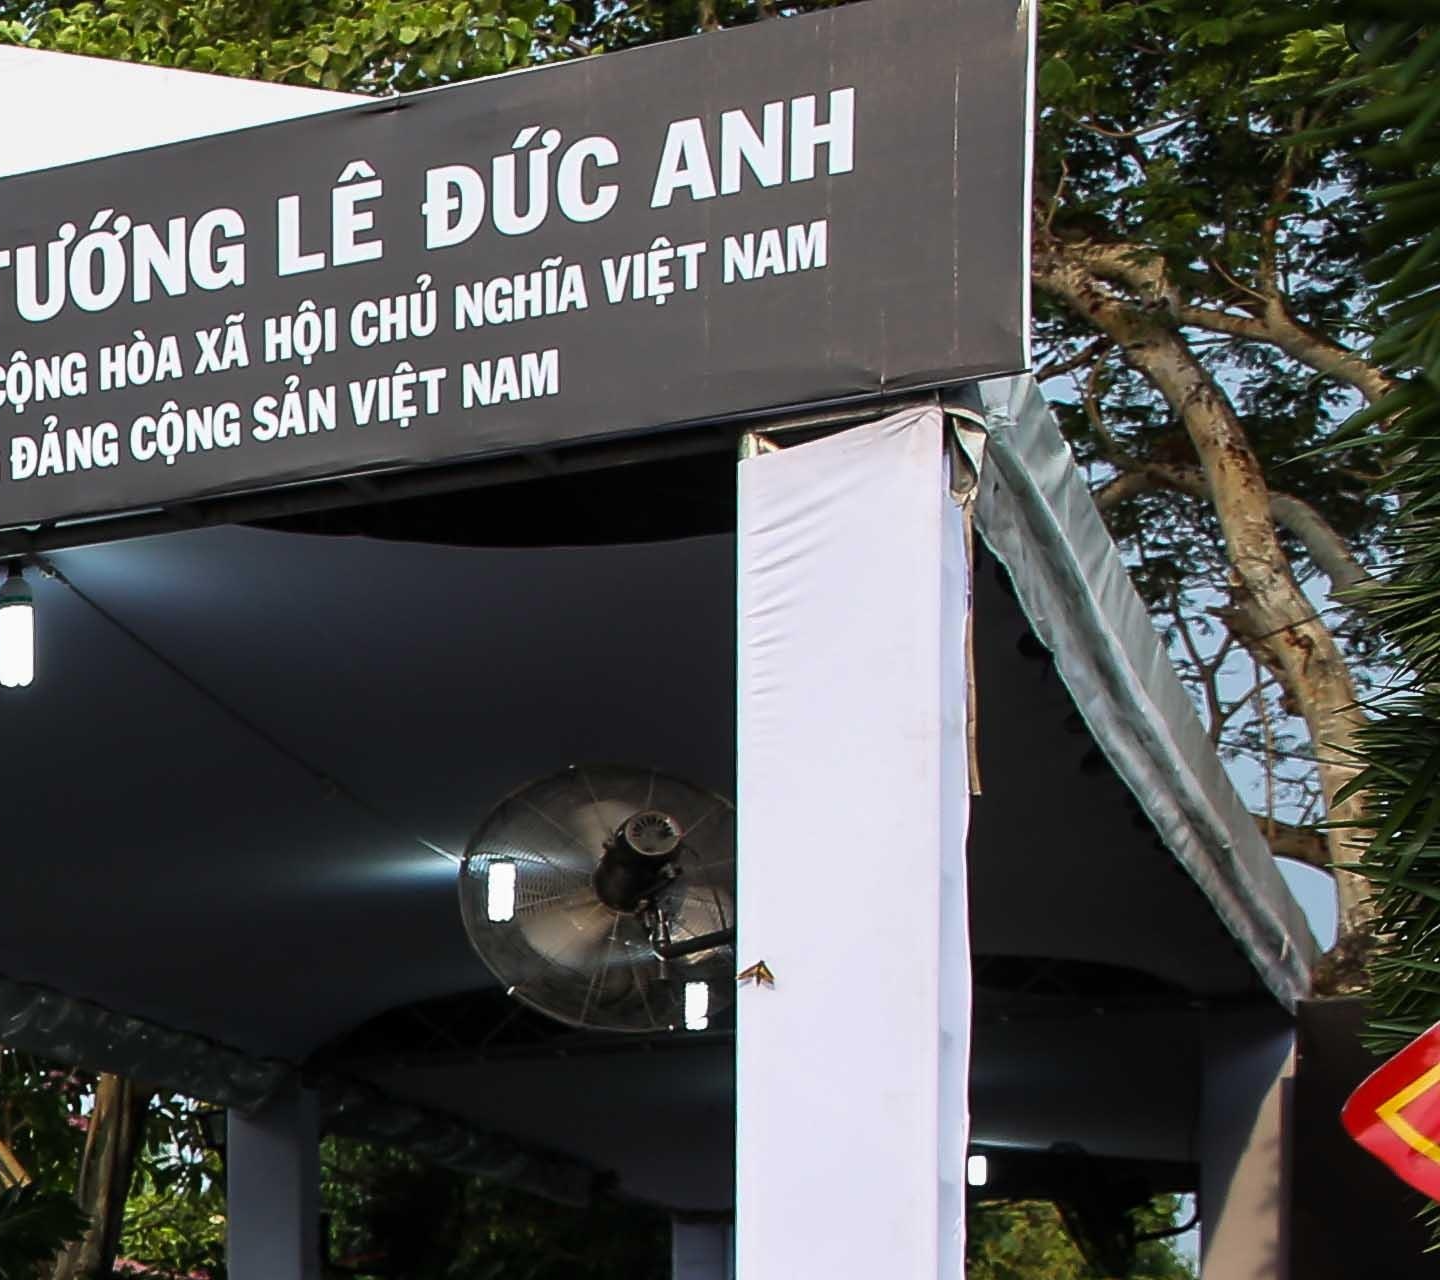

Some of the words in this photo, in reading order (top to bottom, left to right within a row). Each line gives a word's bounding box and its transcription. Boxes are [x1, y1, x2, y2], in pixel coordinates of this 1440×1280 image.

[278, 160, 383, 276] LÊ
[421, 125, 619, 249] ĐỨC
[650, 87, 855, 208] ANH
[100, 329, 183, 391] HÒA
[194, 312, 250, 375] XÃ
[264, 299, 337, 365] HỘI
[350, 273, 437, 347] CHỦ
[455, 255, 589, 330] NGHĨA
[601, 236, 707, 305] VIỆT
[723, 219, 827, 283] NAM
[9, 415, 119, 480] ĐẢNG
[130, 400, 241, 465] CỘNG
[252, 375, 337, 441] SẢN
[348, 361, 447, 428] VIỆT
[462, 349, 559, 409] NAM
